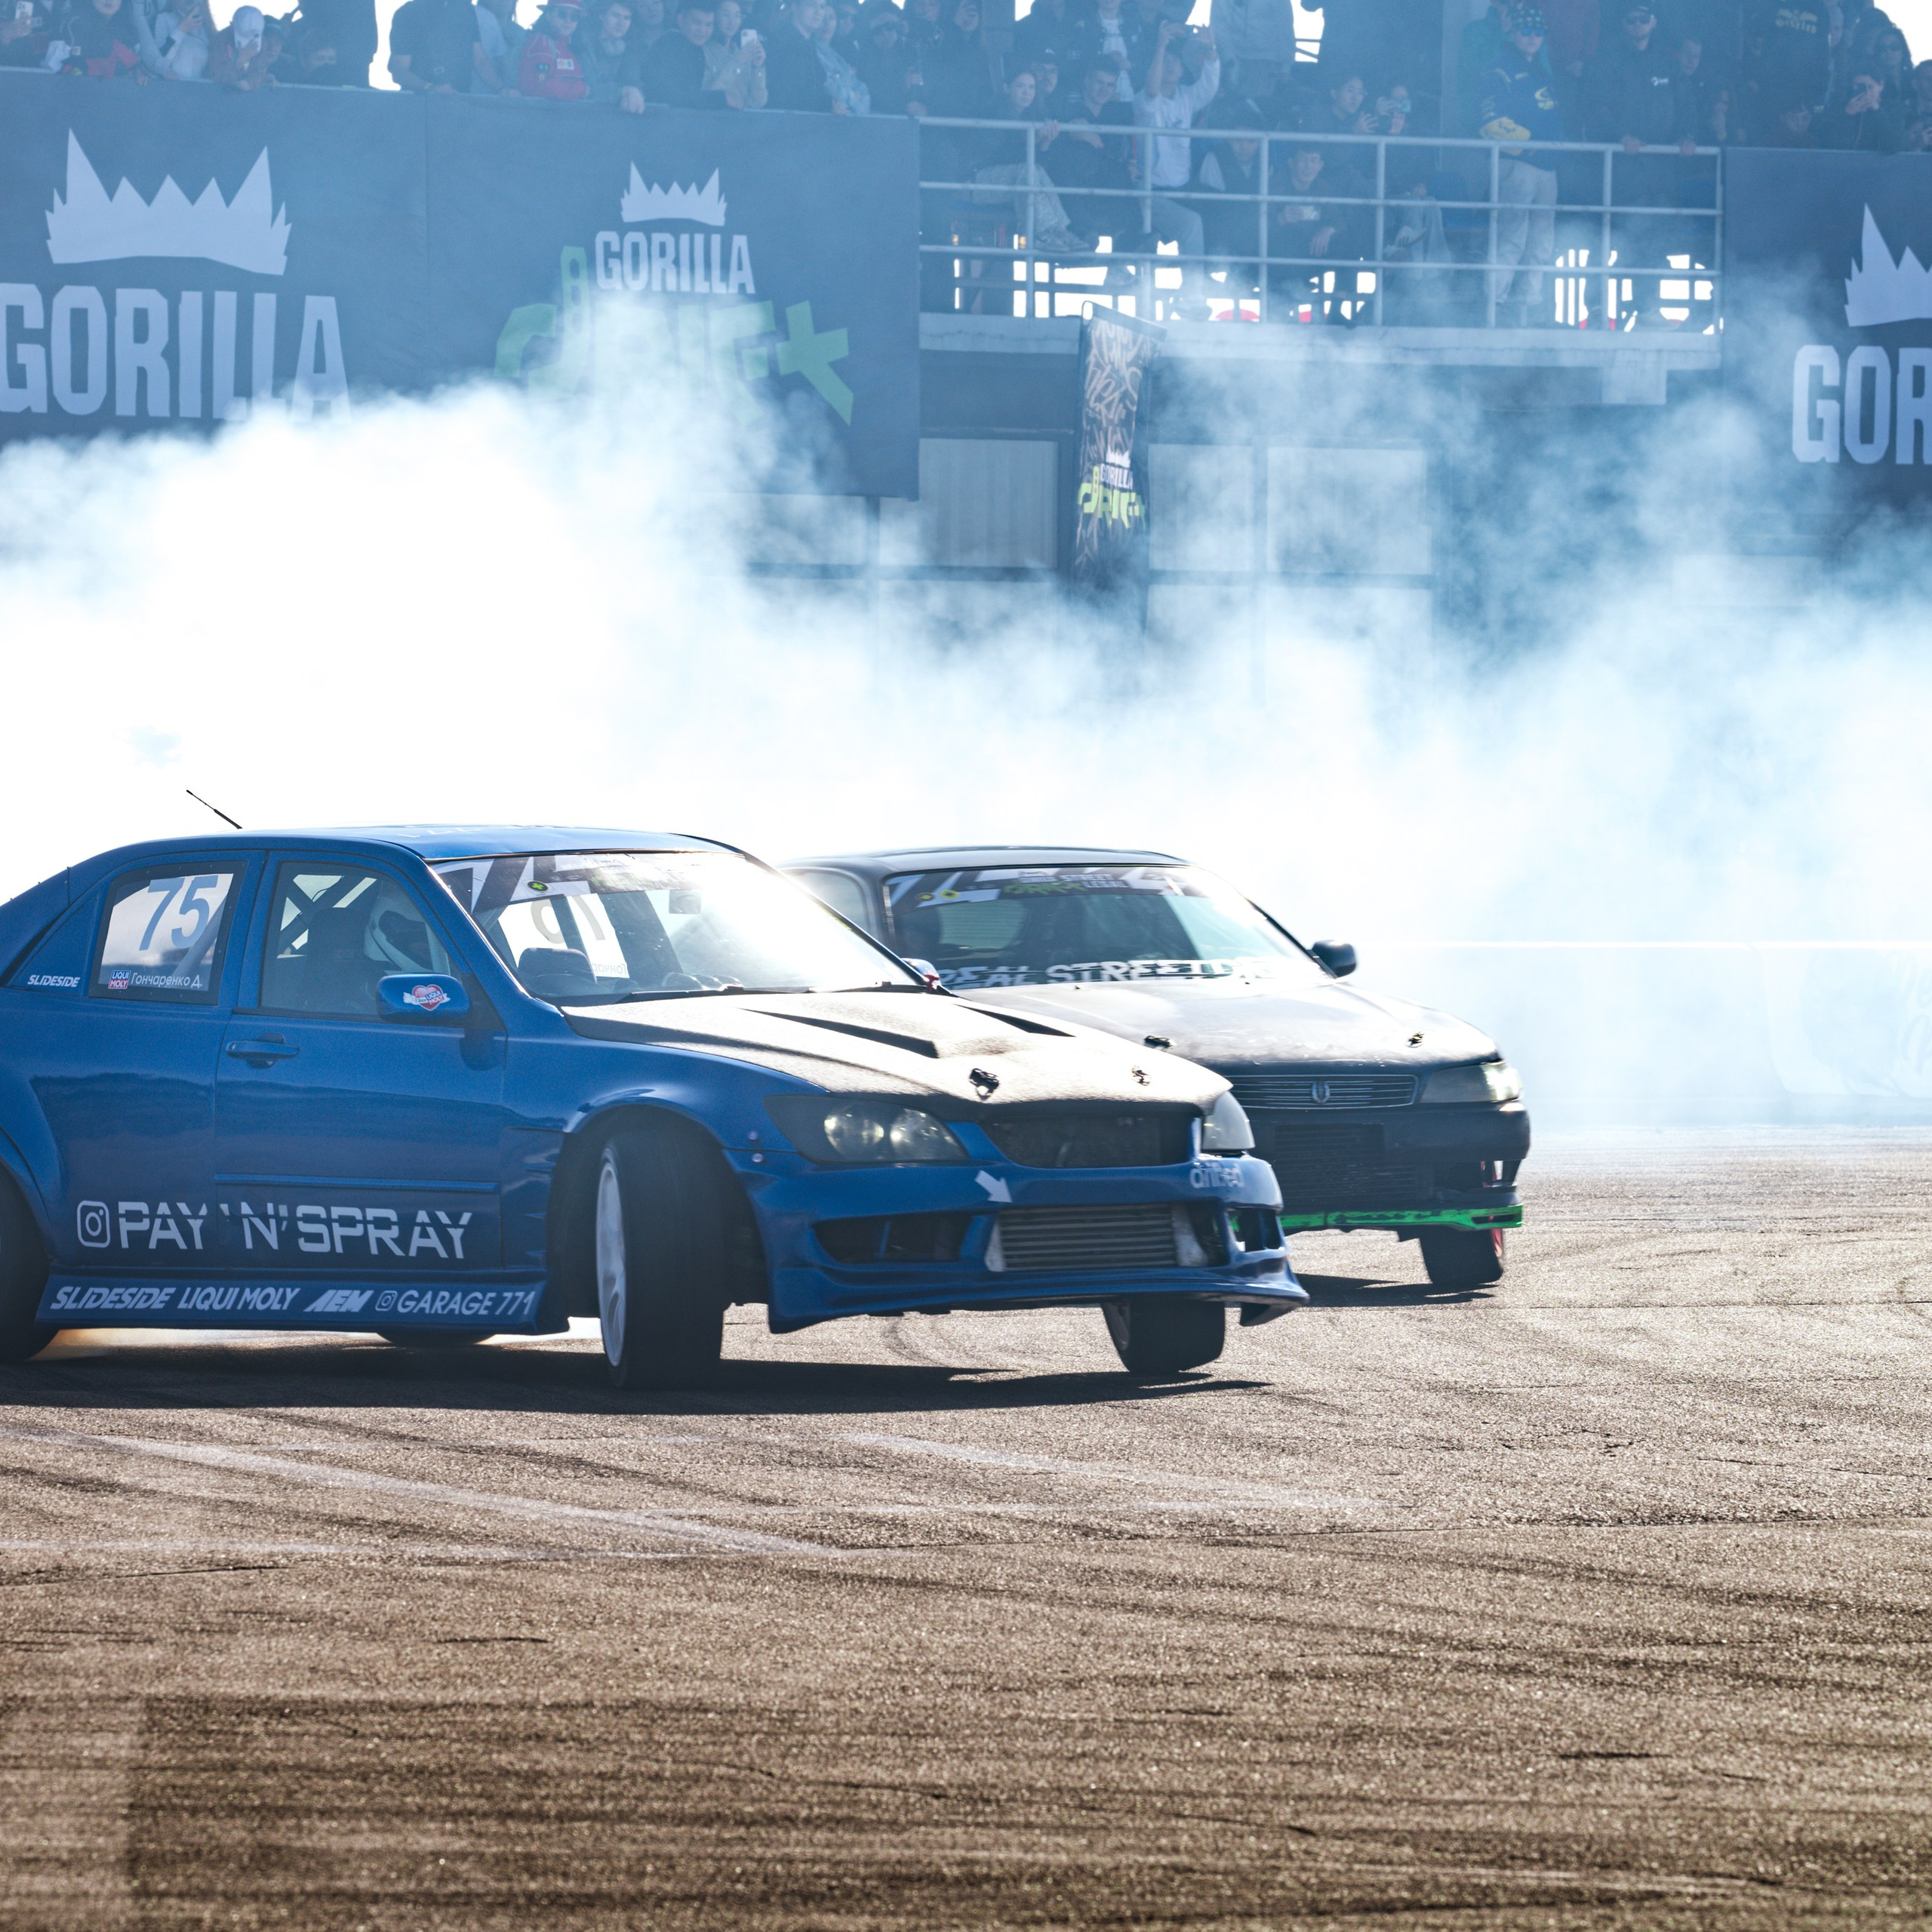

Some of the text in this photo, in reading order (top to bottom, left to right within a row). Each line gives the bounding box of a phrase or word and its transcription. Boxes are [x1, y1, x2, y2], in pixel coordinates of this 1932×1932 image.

[595, 230, 756, 294] GORILLA
[0, 282, 353, 425] GORILLA
[139, 875, 219, 952] 75
[27, 974, 81, 988] SLIDESIDE
[109, 980, 128, 988] MOLY
[112, 971, 130, 980] LIQUI
[131, 972, 191, 988] Гончаренко
[118, 1201, 208, 1251] PAY
[297, 1204, 473, 1260] SPRAY
[50, 1286, 177, 1310] SLIDESIDE
[177, 1287, 240, 1312] LIQUI
[235, 1287, 301, 1311] MOLY
[396, 1290, 497, 1315] GARAGE
[494, 1291, 536, 1315] 771
